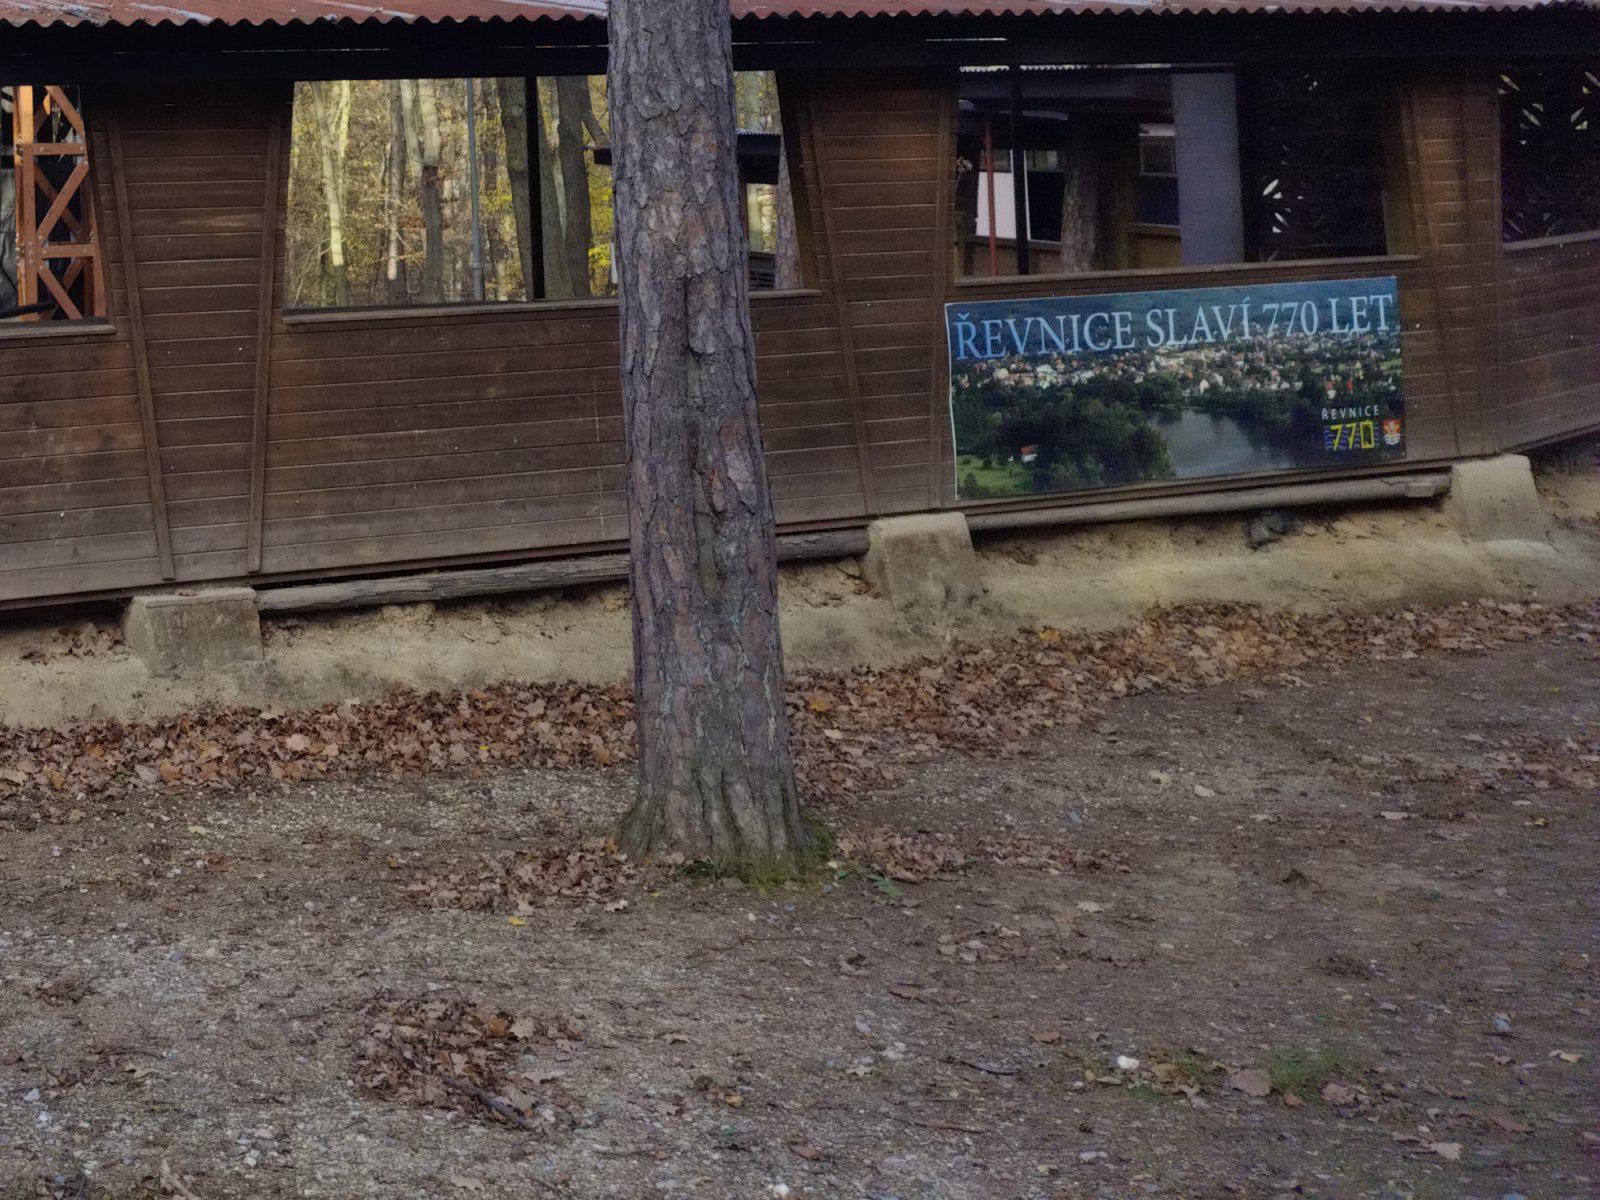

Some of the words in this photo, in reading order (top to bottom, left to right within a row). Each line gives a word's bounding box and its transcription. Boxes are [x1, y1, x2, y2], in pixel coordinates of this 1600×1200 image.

[953, 312, 1136, 360] ŘEVNICE
[1146, 296, 1252, 348] SLAVÍ
[1262, 300, 1319, 339] 770
[1328, 293, 1393, 334] LET
[1330, 420, 1375, 452] 770
